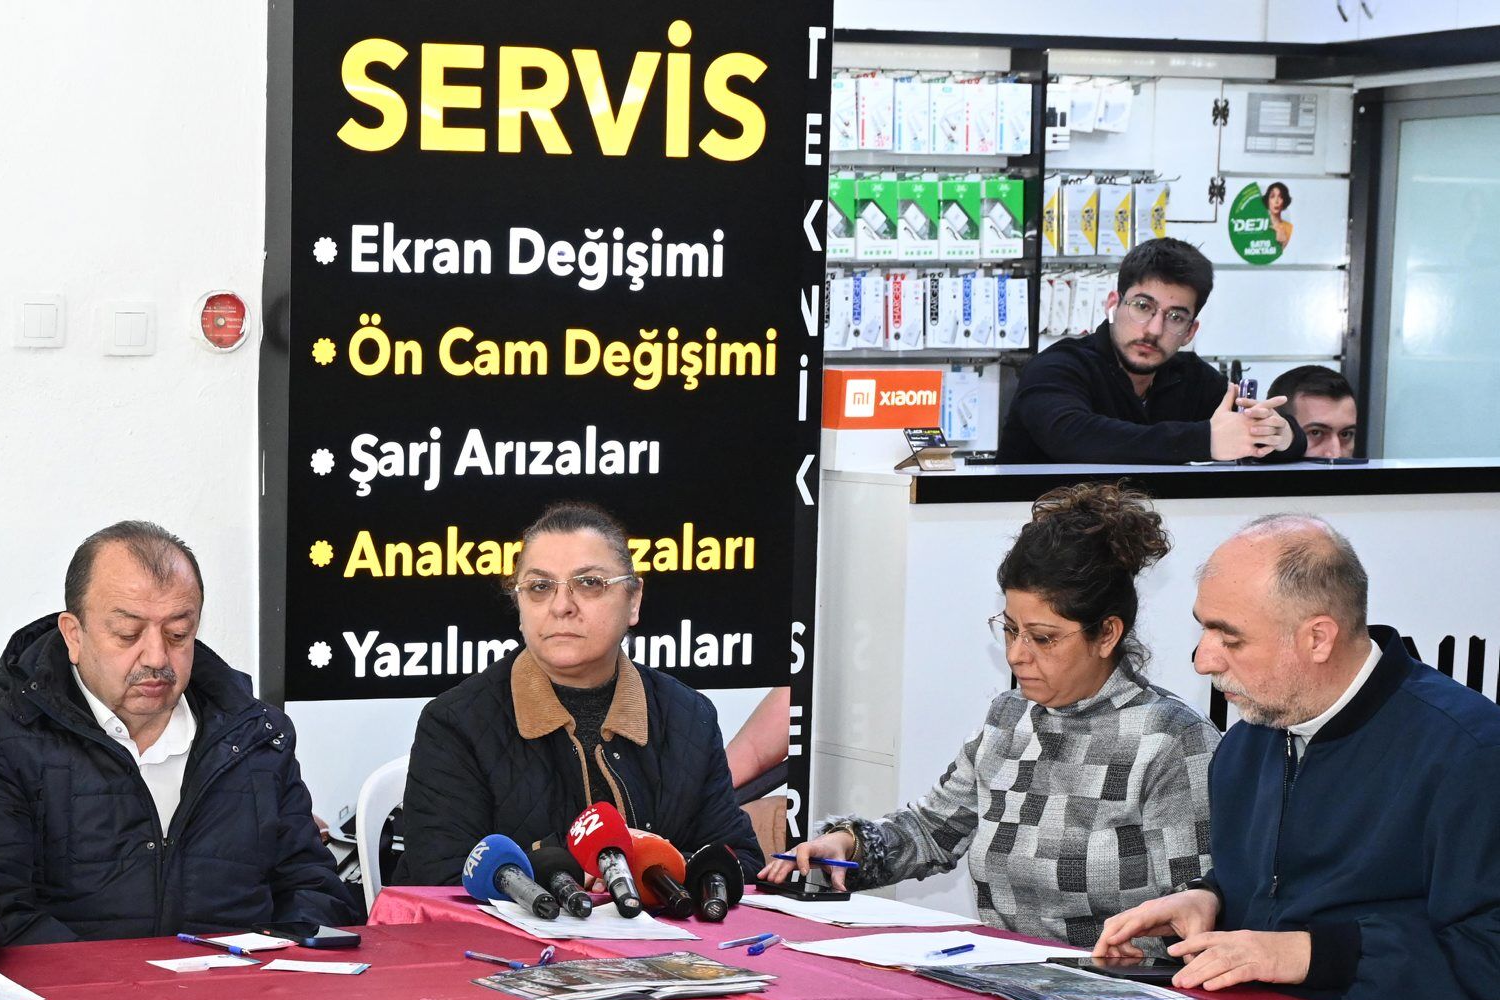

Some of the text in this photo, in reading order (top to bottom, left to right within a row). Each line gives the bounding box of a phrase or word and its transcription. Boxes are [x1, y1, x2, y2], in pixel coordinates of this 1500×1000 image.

[337, 19, 768, 162] SERVİS
[351, 221, 725, 292] Ekran Değişimi
[893, 281, 902, 328] CHARGER
[930, 278, 939, 325] CHARGER
[348, 313, 778, 391] Ön Cam Değişimi
[348, 425, 660, 497] Şarj Arızaları
[343, 522, 755, 578] Anakar zaları
[342, 619, 753, 678] Yazılım unları
[574, 813, 604, 846] 32
[463, 841, 491, 879] AA
